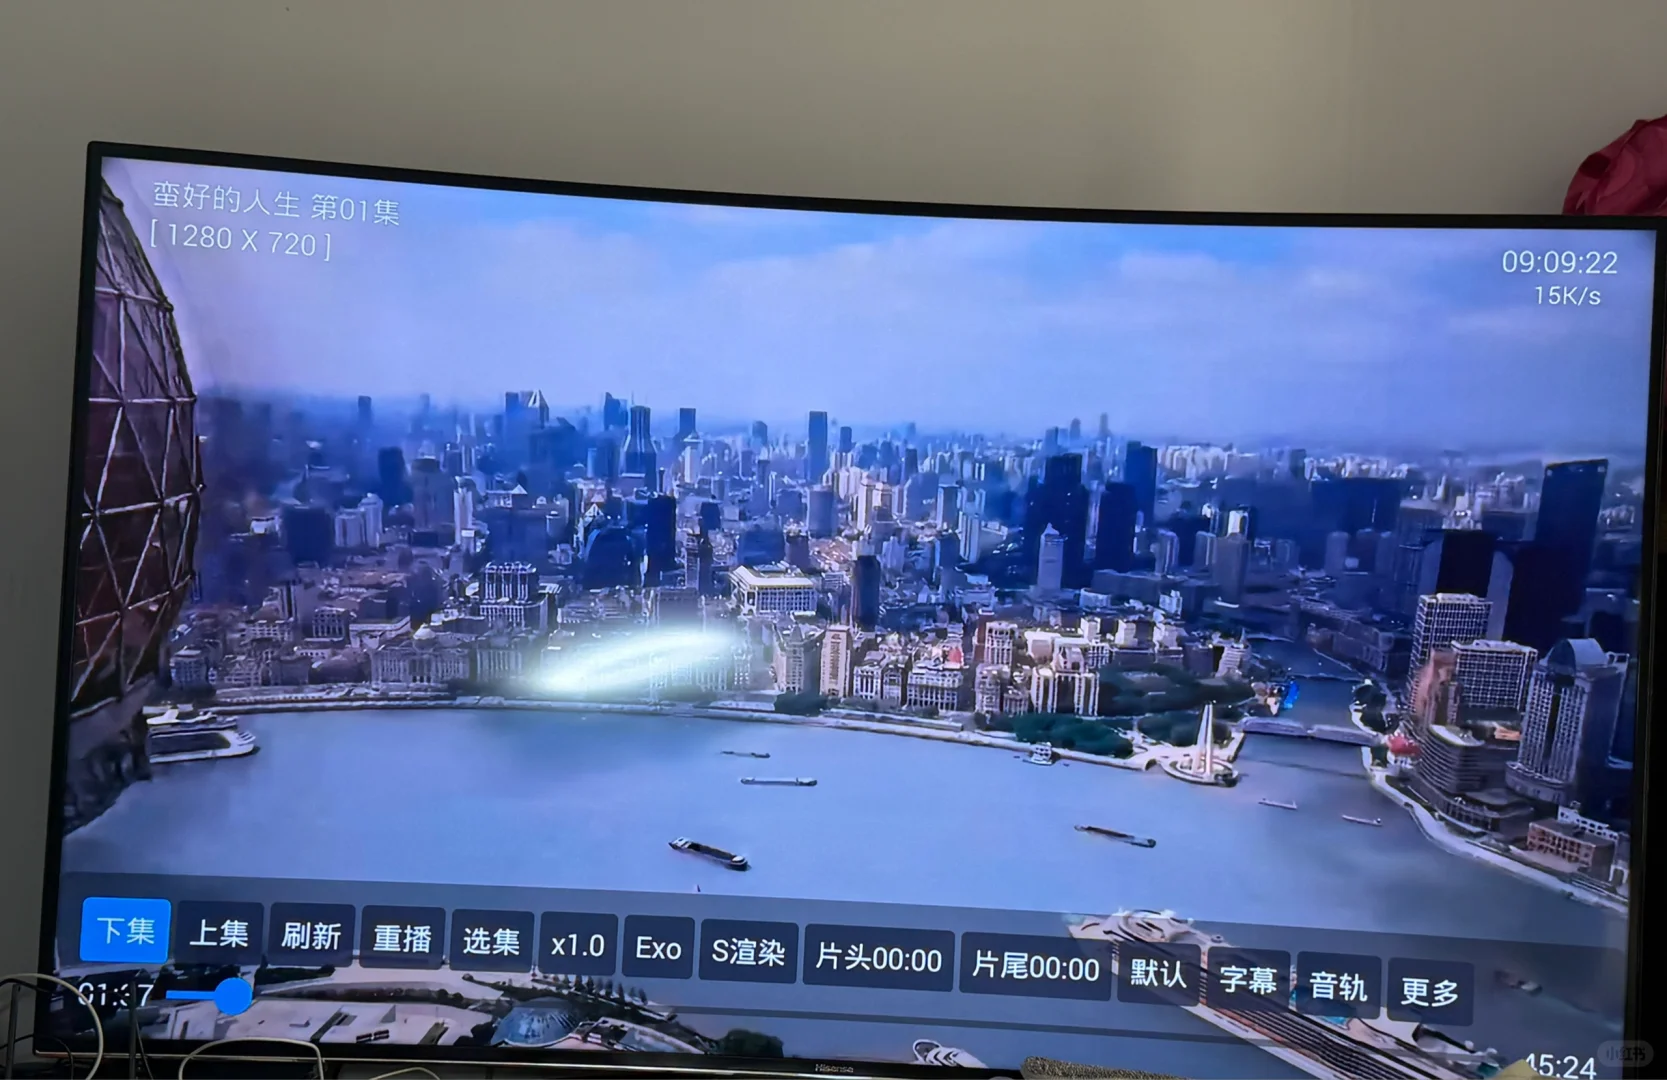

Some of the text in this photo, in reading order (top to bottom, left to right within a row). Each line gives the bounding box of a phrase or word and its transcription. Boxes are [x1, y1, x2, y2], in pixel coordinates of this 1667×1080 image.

[153, 180, 400, 226] 蛮好的人生 第01集
[1502, 250, 1618, 274] 09:09:22
[1535, 286, 1601, 306] 15K/s
[97, 917, 155, 945] 下集
[189, 919, 248, 948] 上集
[281, 922, 341, 950] 刷新
[373, 924, 432, 954] 重播
[463, 927, 520, 956] 选集
[551, 933, 605, 957] x1.0
[635, 936, 682, 960] Exo
[712, 938, 785, 967] S渲染
[816, 942, 942, 973] 片头00:00
[972, 949, 1100, 981] 片尾00:00
[1130, 958, 1187, 988] 默认
[1219, 965, 1278, 995] 字幕
[1309, 971, 1368, 1002] 音轨
[1400, 977, 1459, 1007] 更多
